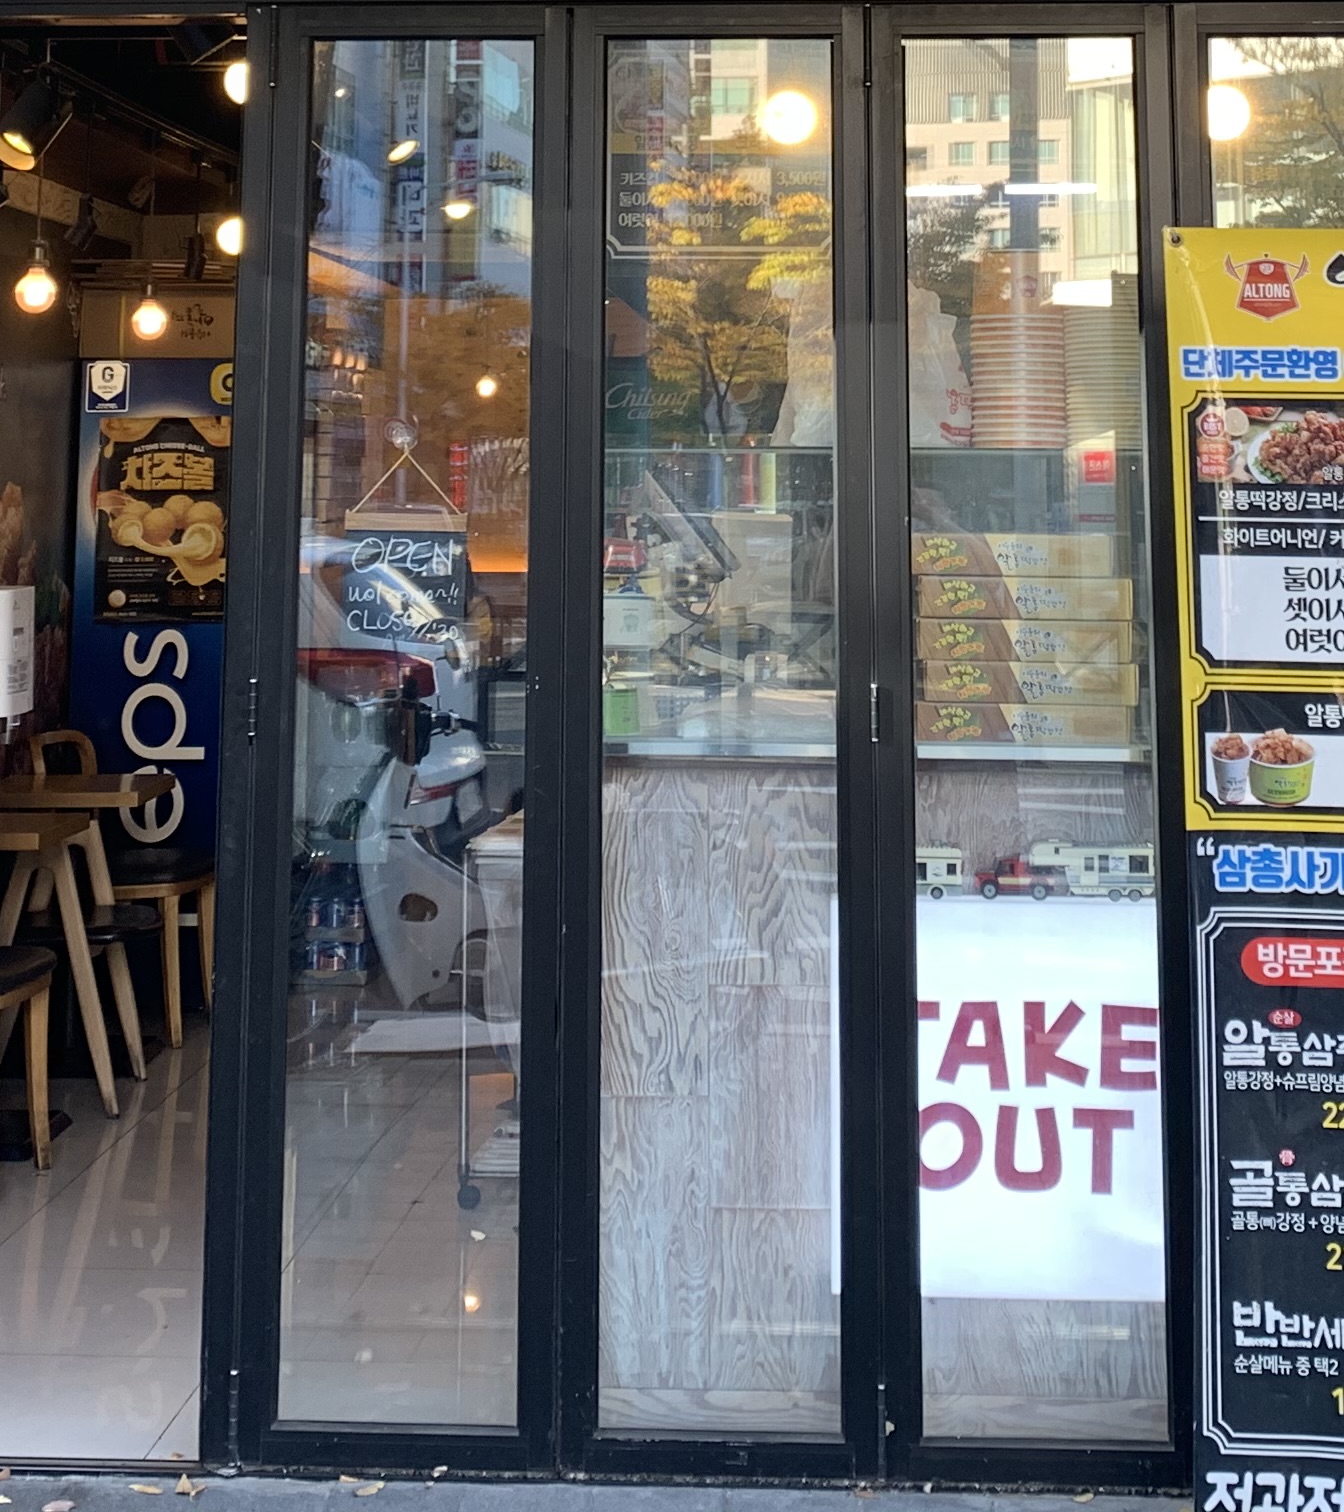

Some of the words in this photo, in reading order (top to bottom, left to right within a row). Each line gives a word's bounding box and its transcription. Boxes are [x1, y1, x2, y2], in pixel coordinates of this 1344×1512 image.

[1244, 282, 1291, 299] ALTONG
[1182, 347, 1338, 381] 단체주문환영
[350, 536, 454, 575] OPEN
[918, 1101, 1135, 1195] OUT
[1233, 1355, 1293, 1377] 순살메뉴
[1295, 1356, 1312, 1378] 중
